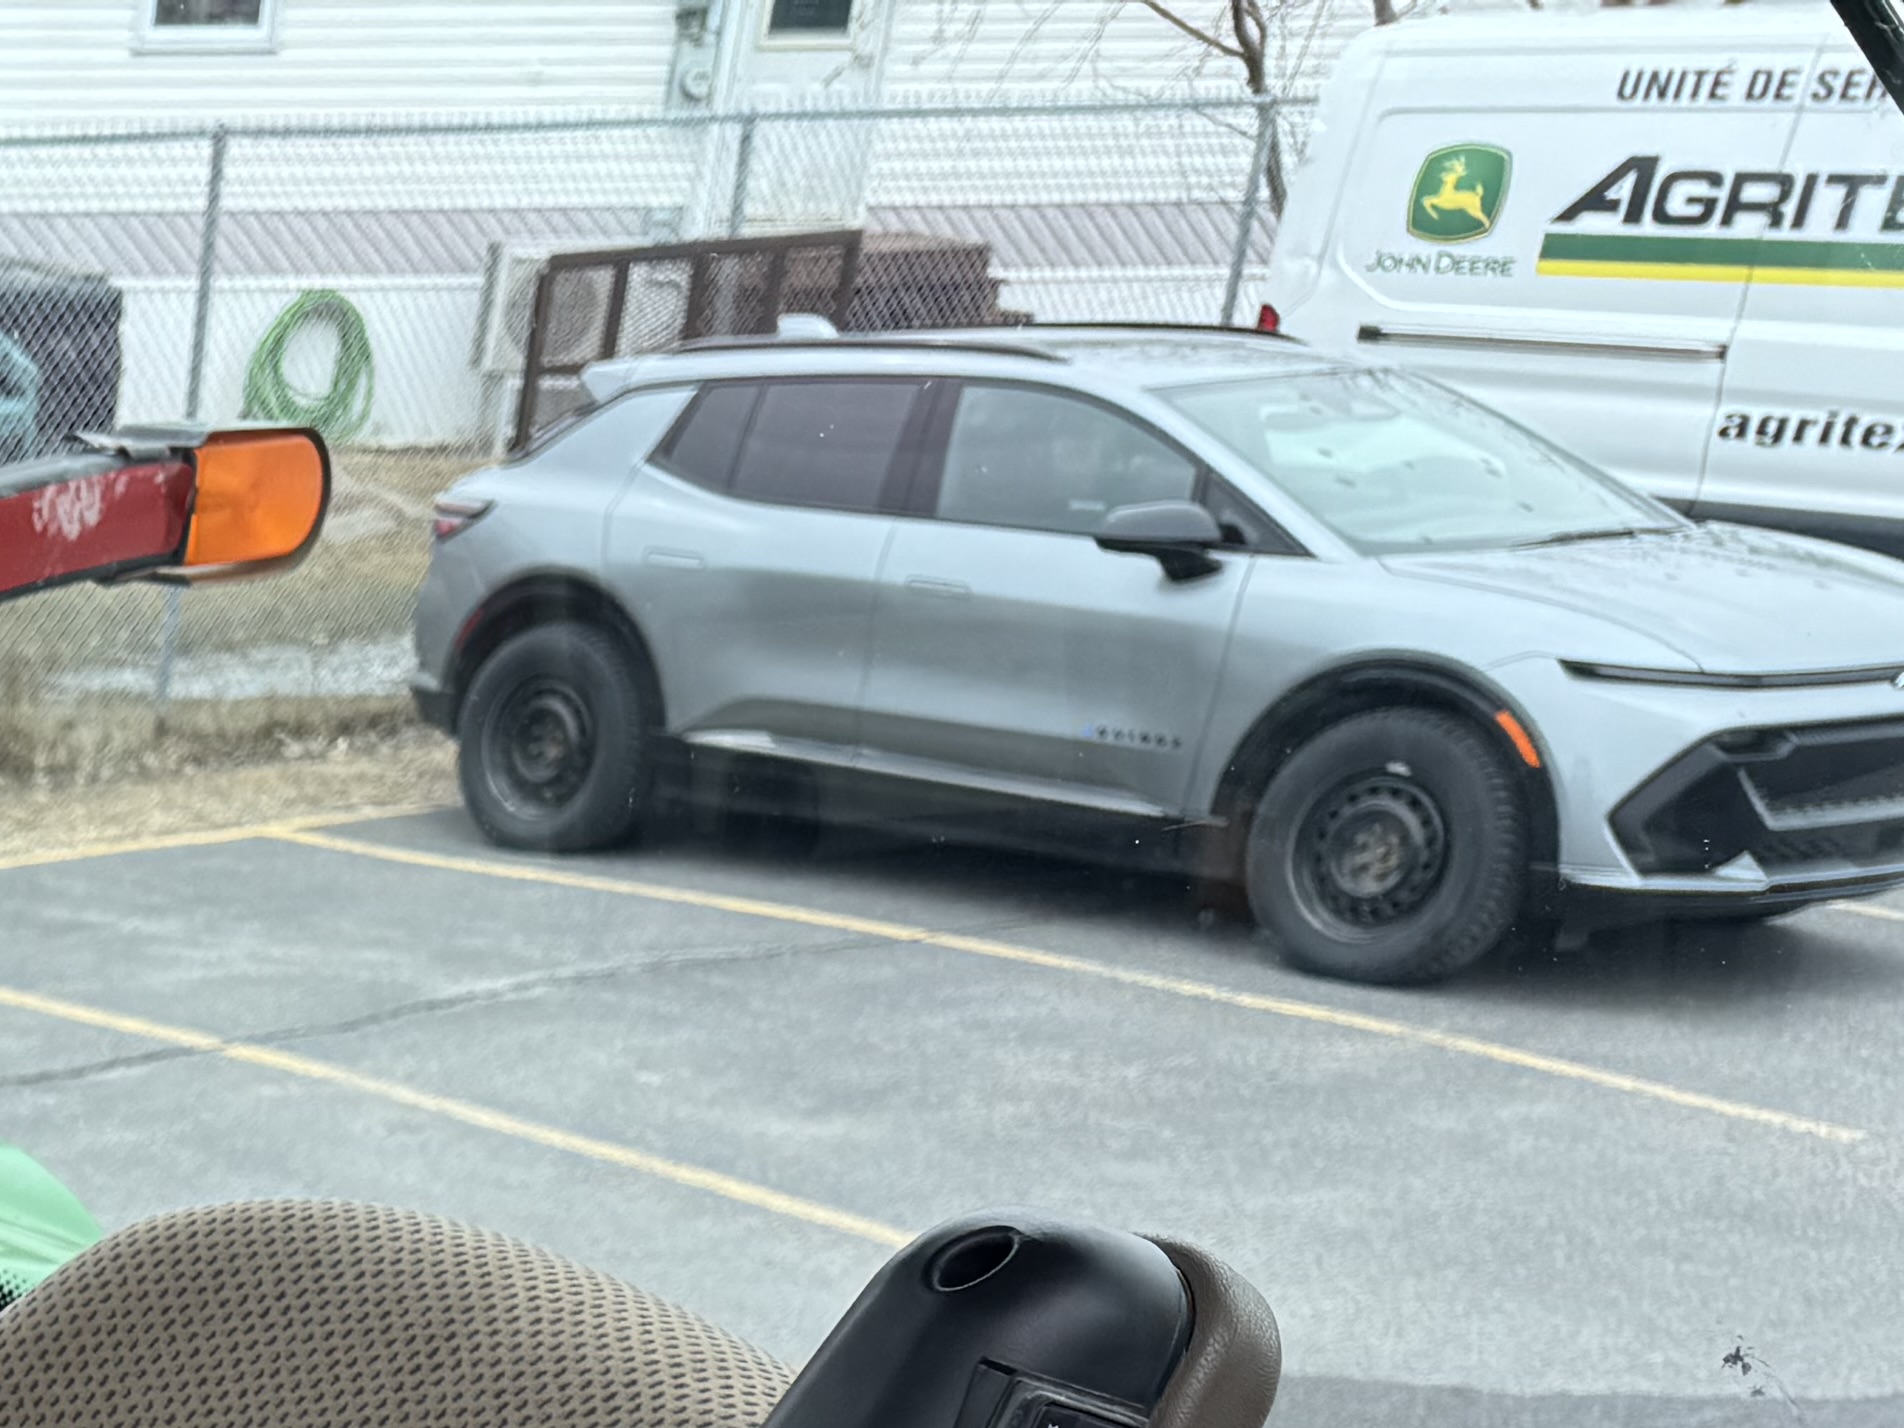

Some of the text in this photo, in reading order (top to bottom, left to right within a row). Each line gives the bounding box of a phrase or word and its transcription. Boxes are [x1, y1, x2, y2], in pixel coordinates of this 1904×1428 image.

[1617, 58, 1737, 102] UNITÉ
[1745, 69, 1804, 102] DE
[1365, 250, 1517, 277] JOHN DEERE
[1718, 410, 1904, 453] agrite
